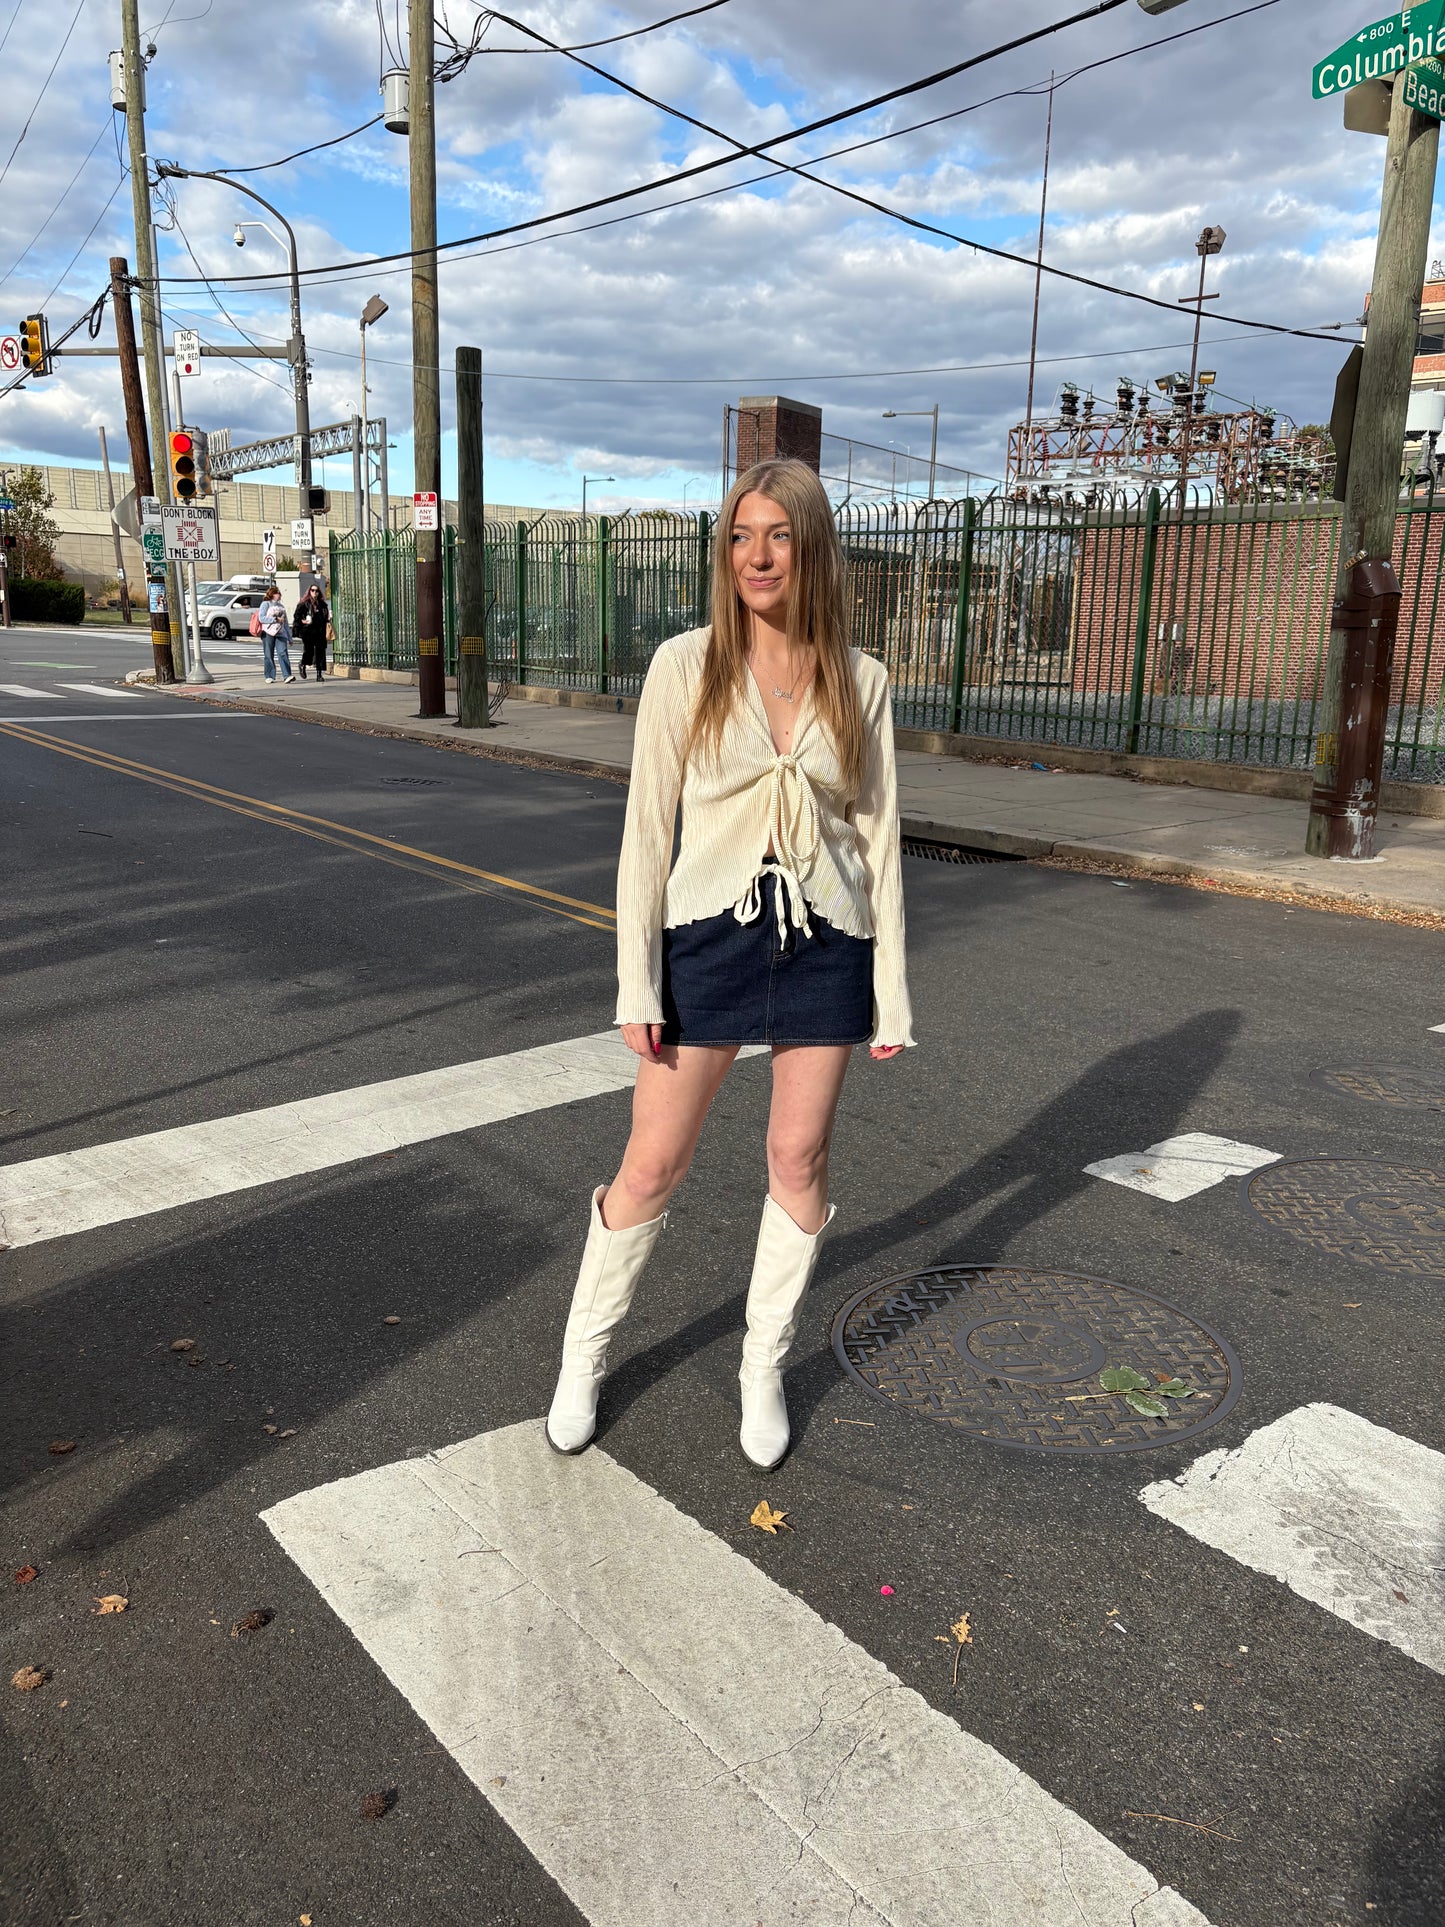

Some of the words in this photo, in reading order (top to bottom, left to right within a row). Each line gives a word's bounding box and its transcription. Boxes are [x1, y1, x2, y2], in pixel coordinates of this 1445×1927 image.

[1369, 21, 1394, 40] 800
[1401, 10, 1412, 28] E
[180, 332, 192, 341] NO
[179, 343, 195, 352] TURN
[176, 354, 185, 362] ON
[187, 352, 199, 361] RED
[421, 494, 429, 502] NO
[187, 509, 213, 520] BLOCK
[296, 521, 305, 530] NO
[294, 530, 309, 538] TURN
[300, 538, 311, 546] RED
[168, 547, 189, 559] THE
[193, 548, 214, 560] BOX
